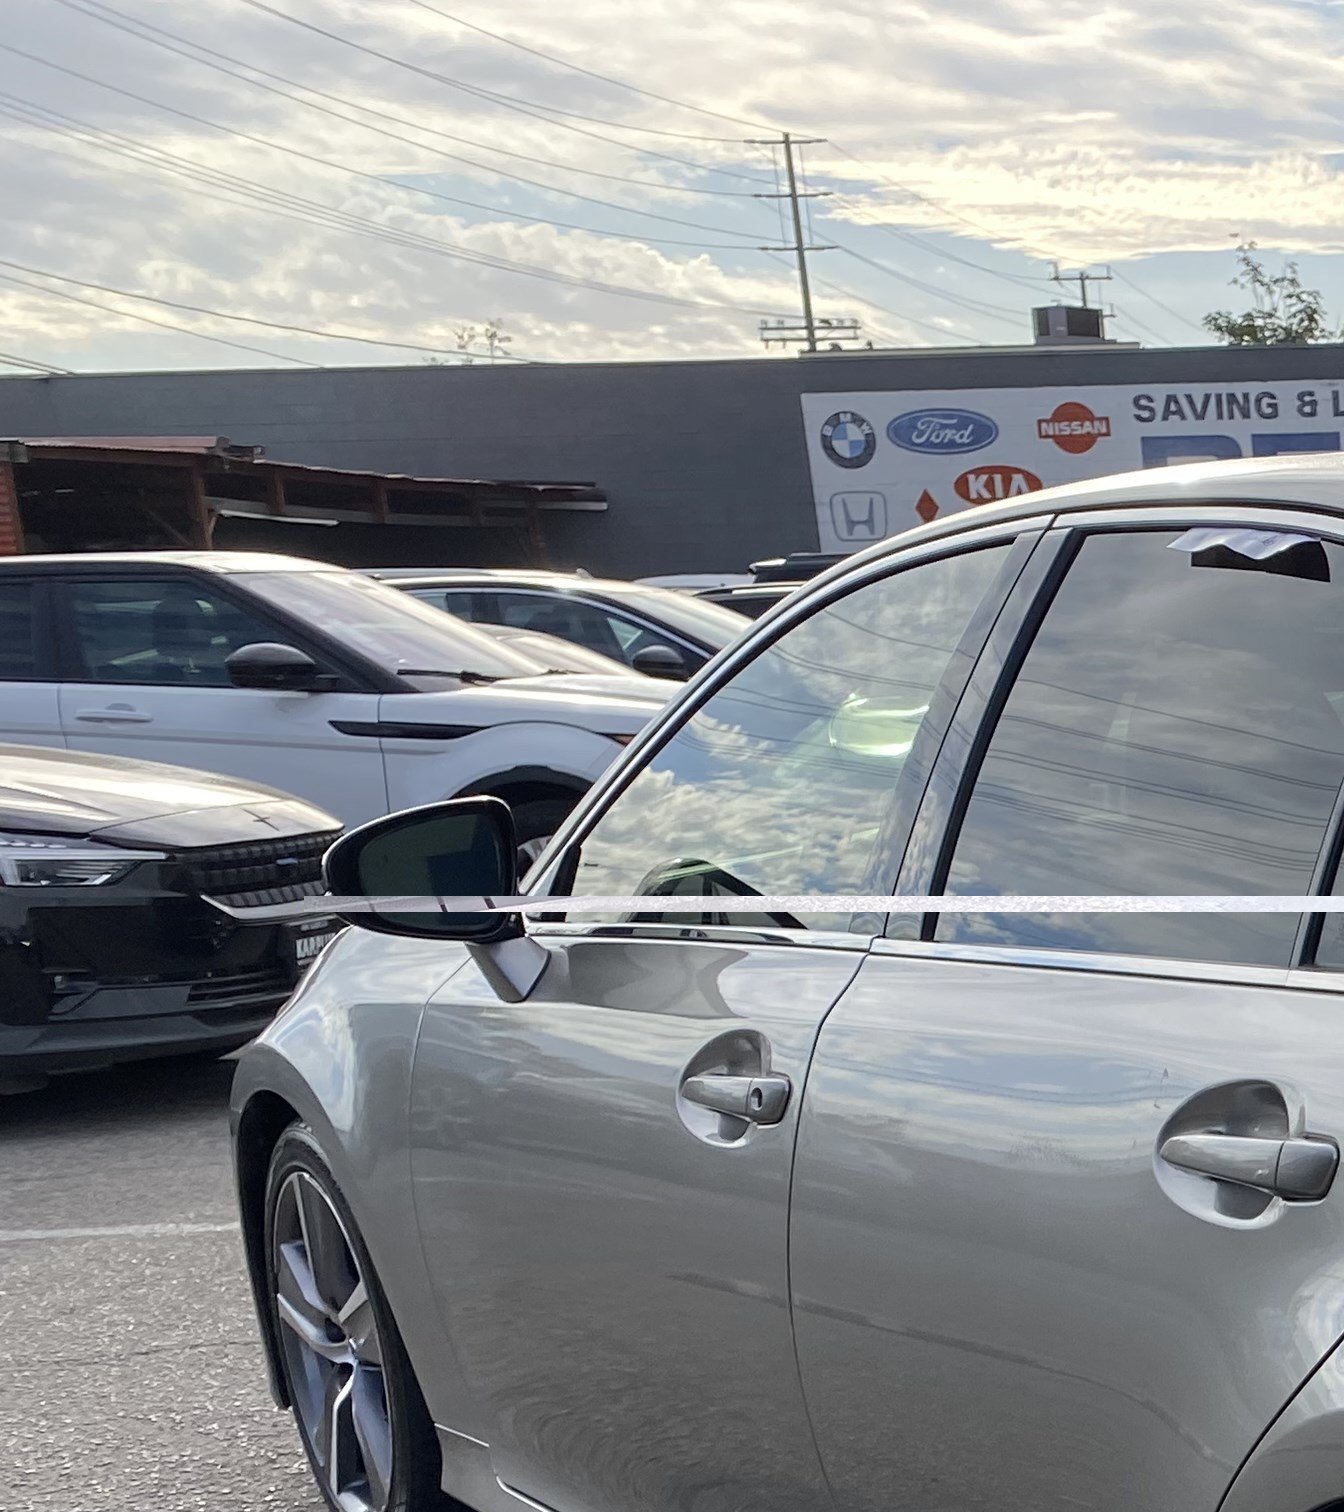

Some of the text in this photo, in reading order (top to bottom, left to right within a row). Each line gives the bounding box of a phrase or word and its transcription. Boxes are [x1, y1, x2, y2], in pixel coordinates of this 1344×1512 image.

[1132, 391, 1279, 423] SAVING
[1296, 390, 1318, 418] &
[911, 416, 974, 445] Ford
[1040, 420, 1107, 436] NISSAN
[967, 473, 1030, 500] KIA
